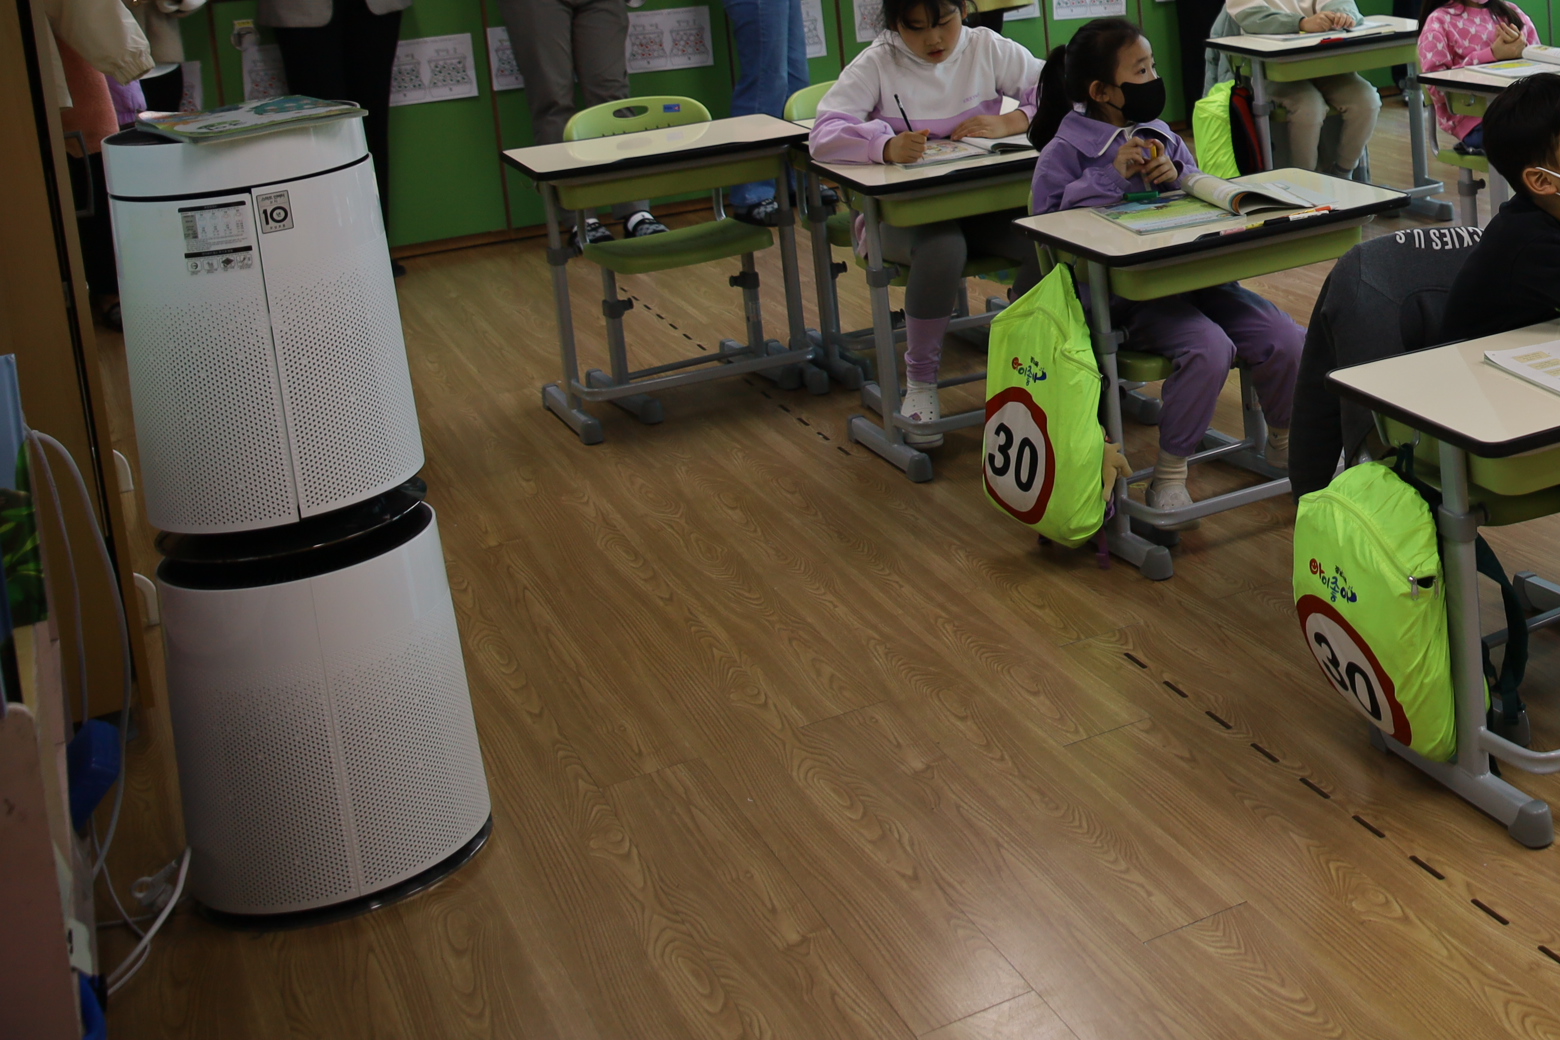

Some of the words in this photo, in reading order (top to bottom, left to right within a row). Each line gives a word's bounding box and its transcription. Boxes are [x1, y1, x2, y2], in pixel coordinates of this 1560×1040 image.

[1430, 226, 1484, 251] CKIES
[988, 422, 1039, 493] 30
[1313, 631, 1382, 722] 30
